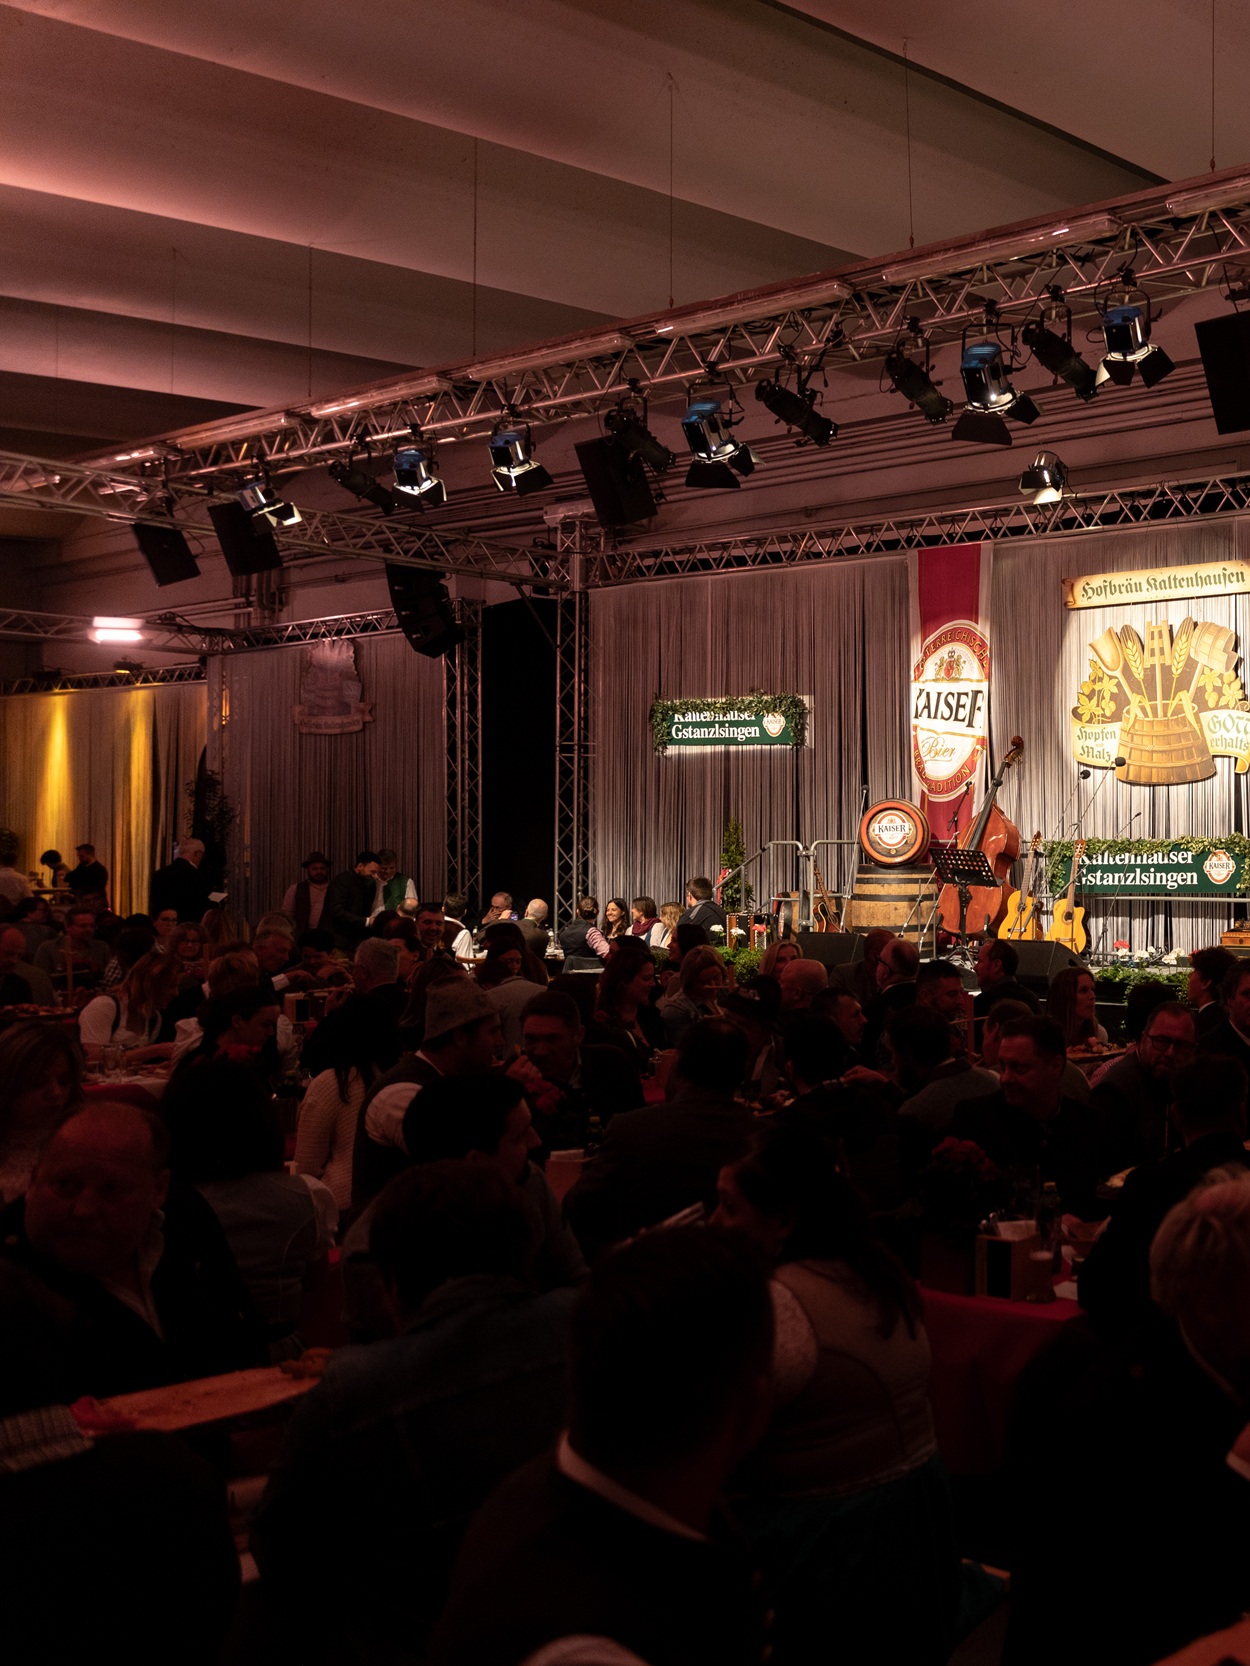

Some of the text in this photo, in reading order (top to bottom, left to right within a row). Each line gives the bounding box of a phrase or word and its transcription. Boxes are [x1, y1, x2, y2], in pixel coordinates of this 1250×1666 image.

[1081, 577, 1143, 602] Hofbräu
[919, 629, 988, 670] ÖTERREICHISCHE
[671, 723, 761, 742] Gstanzlsingen
[1077, 726, 1117, 742] Hopfen
[921, 736, 956, 759] Bier
[1079, 744, 1111, 763] Malz
[878, 824, 906, 833] KAISER
[1208, 862, 1231, 870] KAISER
